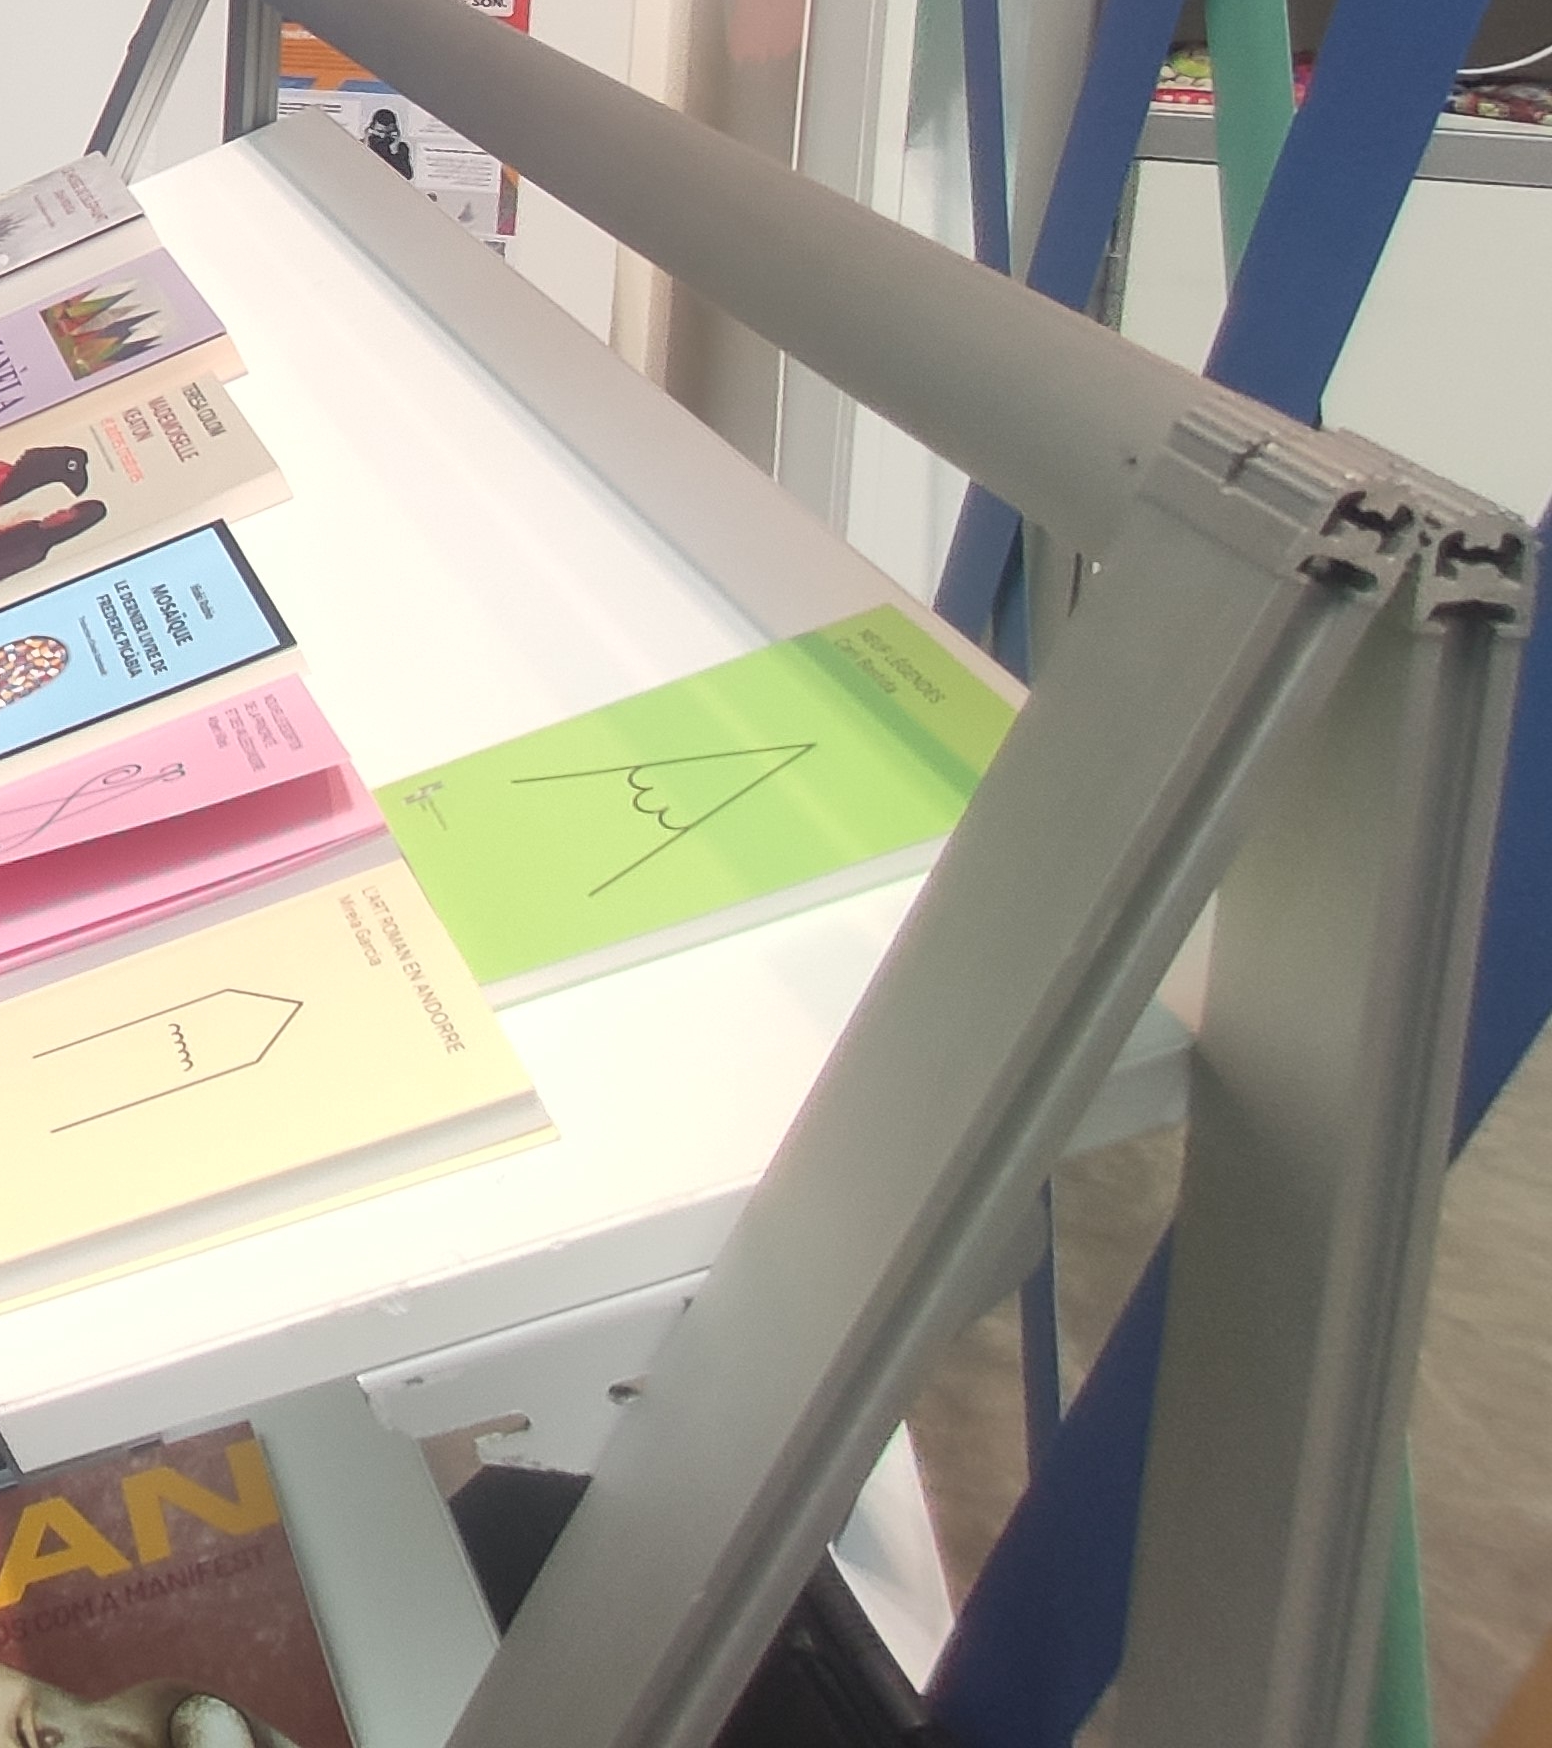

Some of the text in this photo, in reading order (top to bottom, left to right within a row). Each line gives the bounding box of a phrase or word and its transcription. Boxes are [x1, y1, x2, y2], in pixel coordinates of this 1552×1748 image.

[148, 395, 200, 463] MADEMOISELLE
[96, 593, 128, 641] FREDERIC
[113, 579, 169, 676] LE DERNIER LIVRE DE
[150, 583, 194, 648] MOSAÏQUE
[378, 915, 413, 962] ROMAN
[402, 961, 425, 982] EN
[413, 984, 466, 1054] ANDORRE
[36, 1599, 96, 1633] COM
[97, 1590, 122, 1615] A
[123, 1544, 266, 1603] MANIFEST
